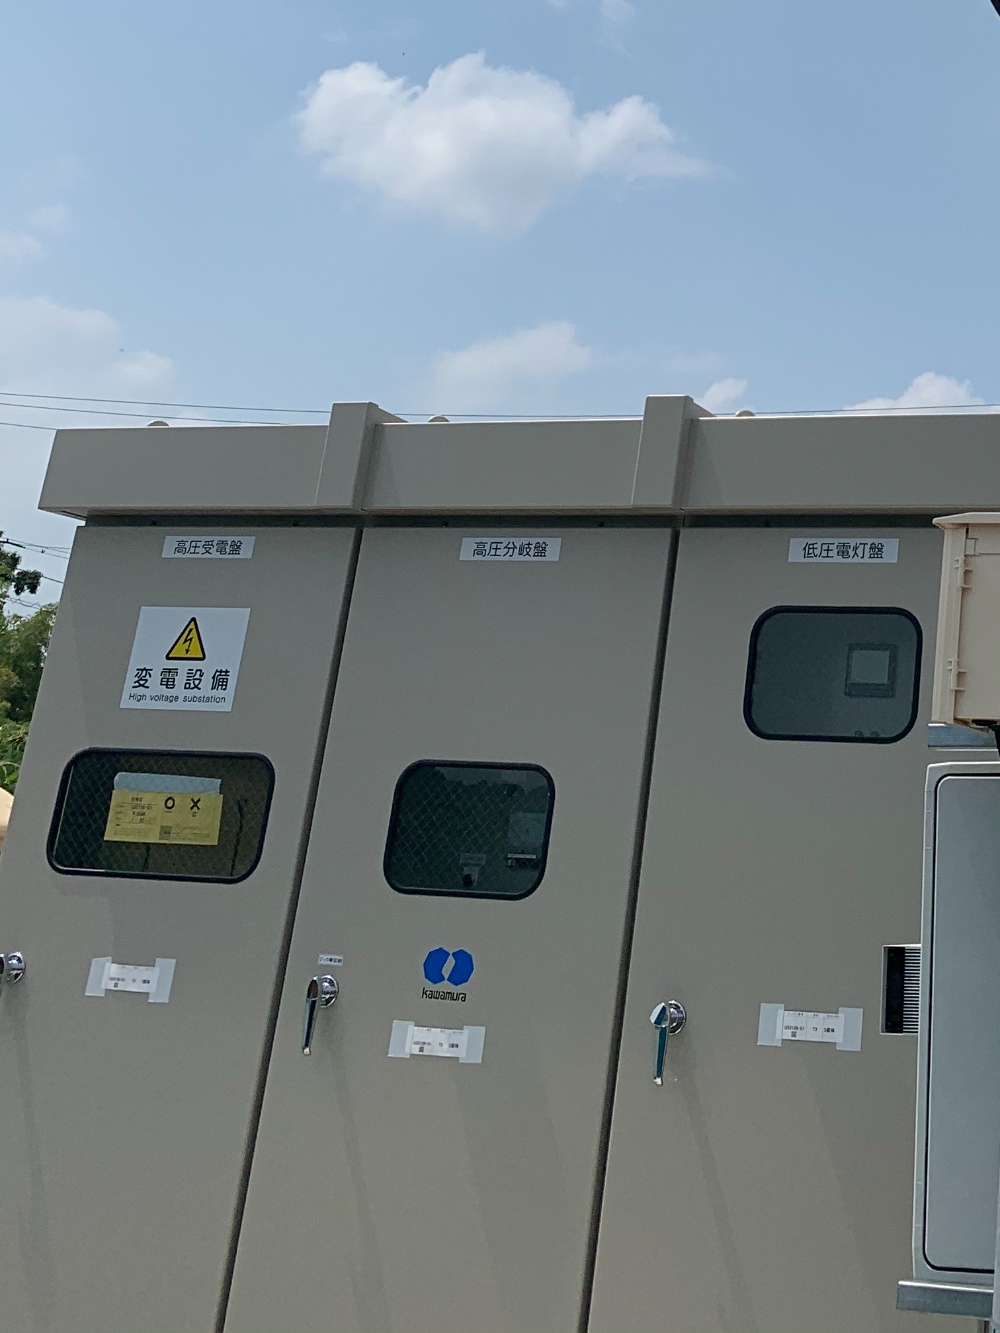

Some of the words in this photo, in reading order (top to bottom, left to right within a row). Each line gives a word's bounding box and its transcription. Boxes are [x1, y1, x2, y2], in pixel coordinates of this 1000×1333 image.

[173, 539, 244, 556] 高圧受電盤
[472, 541, 549, 558] 高圧分岐盤
[802, 541, 885, 559] 低圧電灯盤
[132, 666, 231, 692] 変電設備
[128, 692, 147, 702] High
[150, 694, 179, 703] voltage
[182, 695, 226, 704] substation
[421, 987, 467, 1002] kawamura
